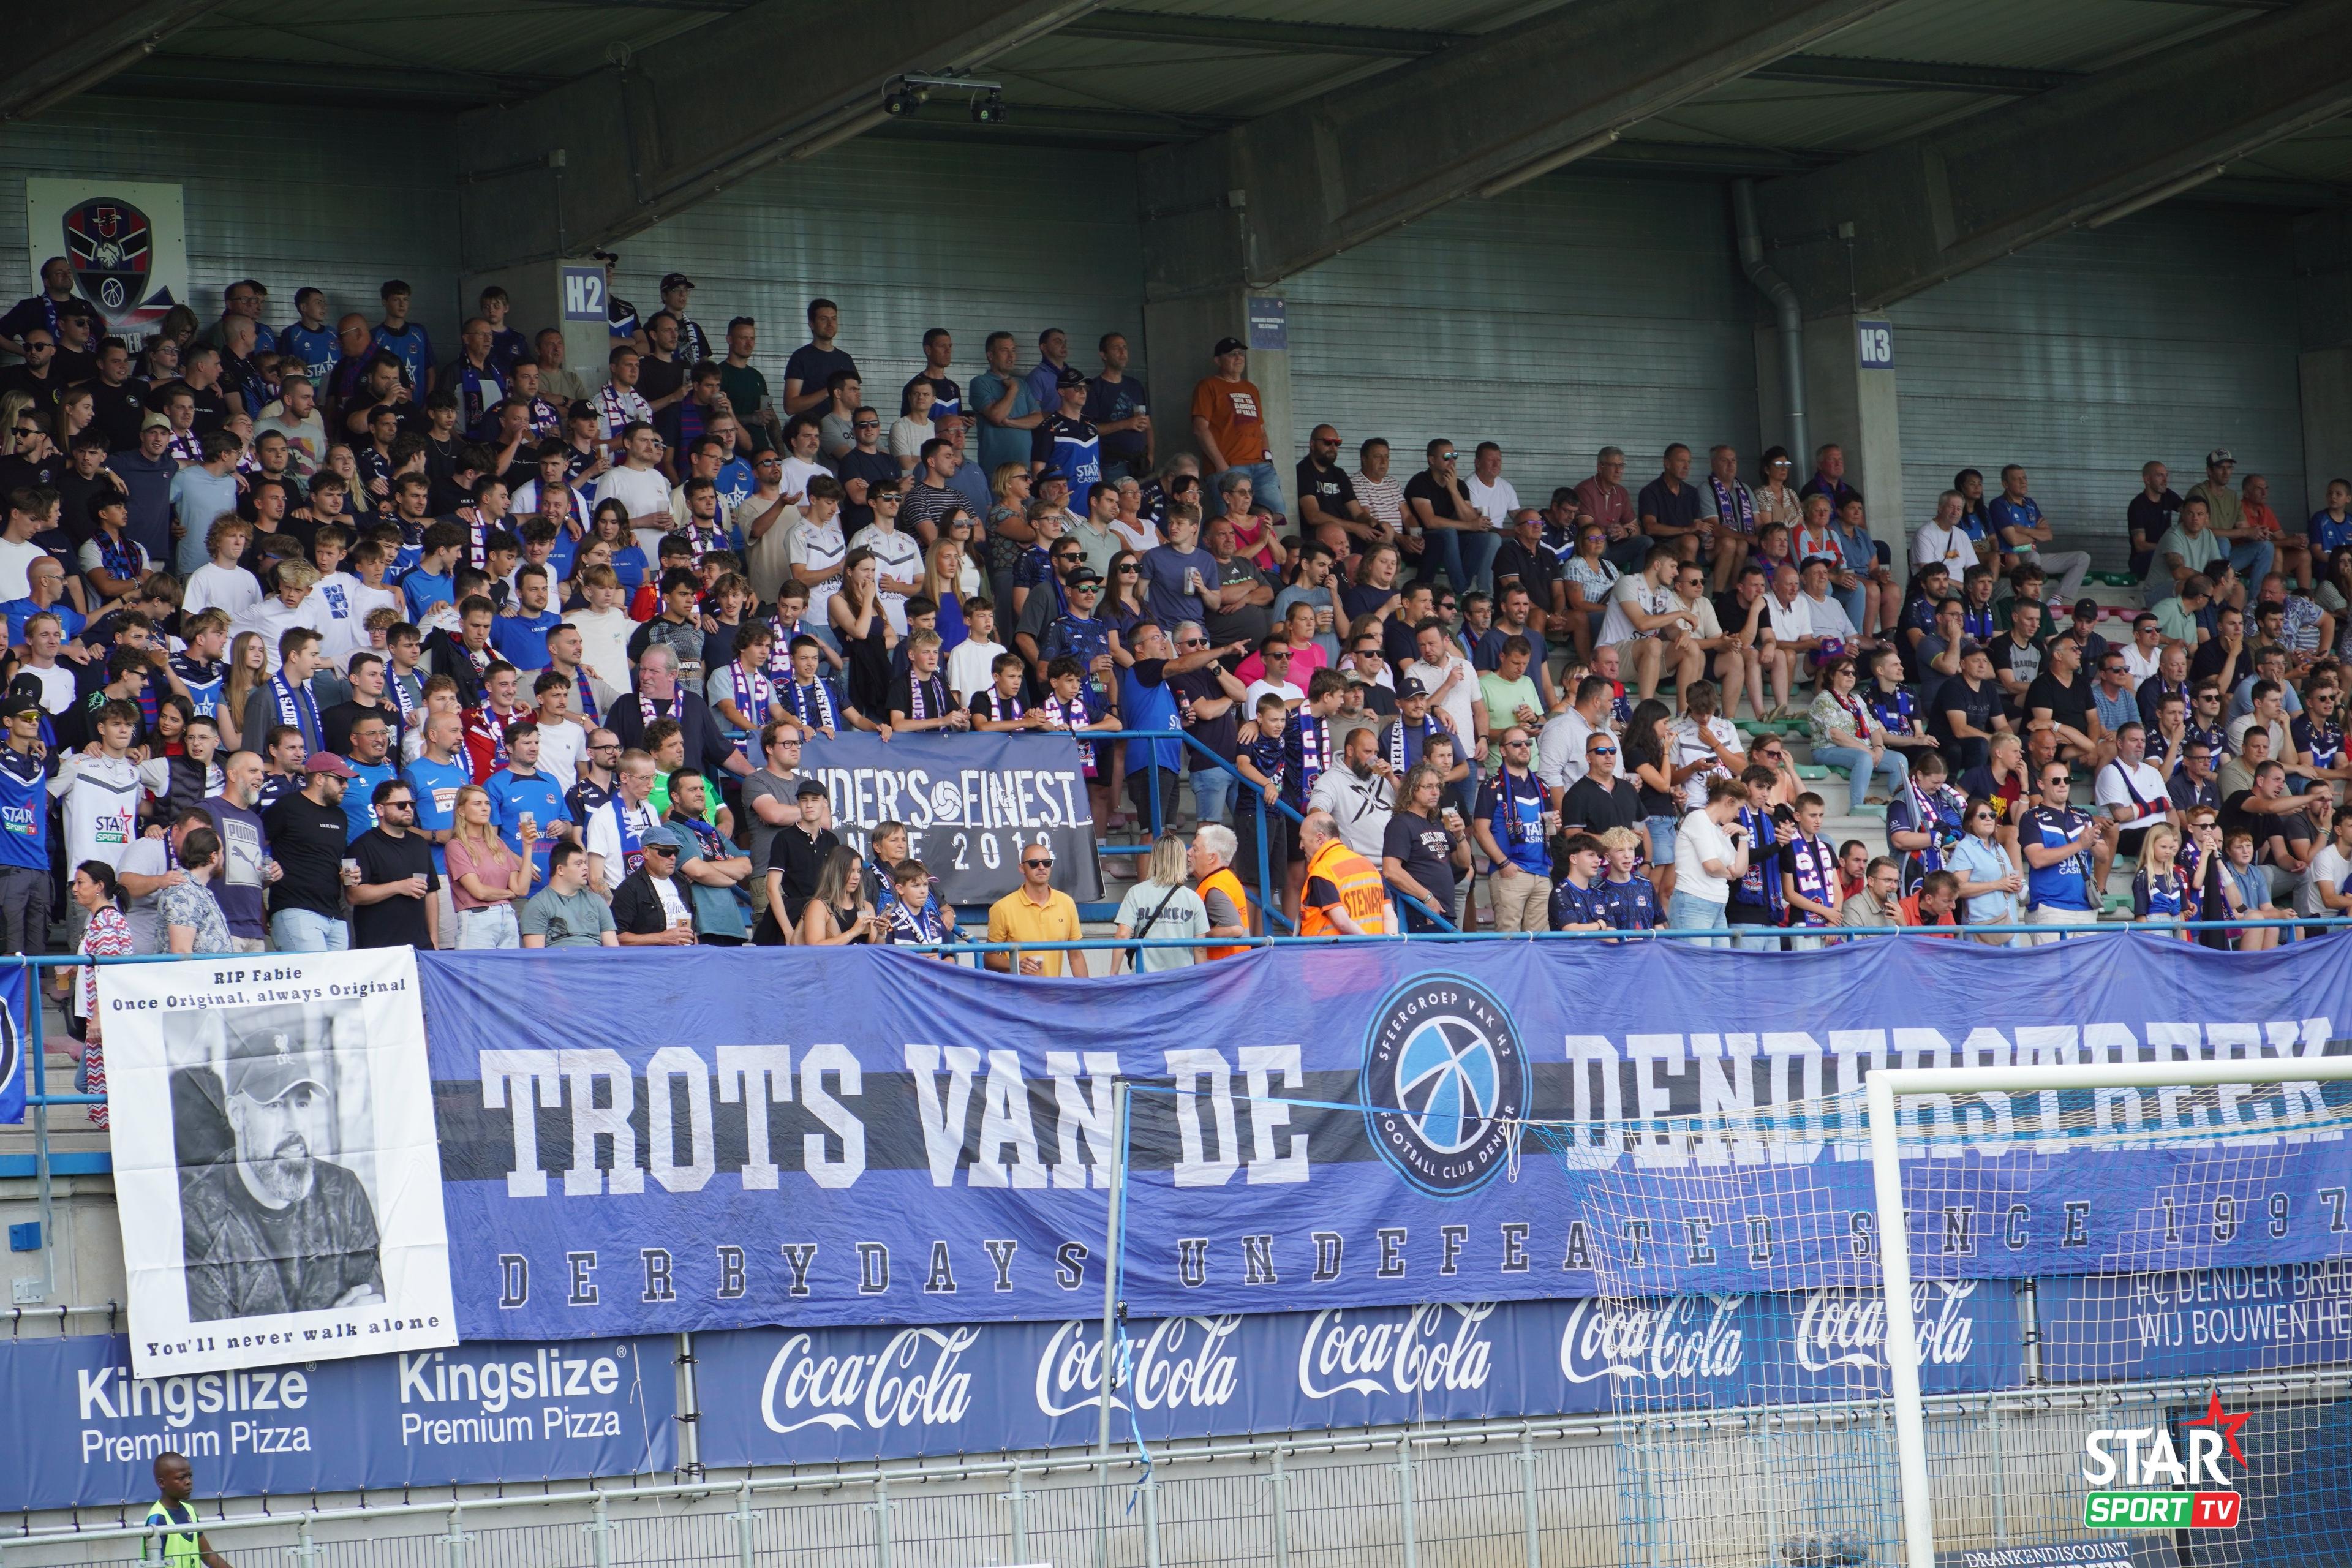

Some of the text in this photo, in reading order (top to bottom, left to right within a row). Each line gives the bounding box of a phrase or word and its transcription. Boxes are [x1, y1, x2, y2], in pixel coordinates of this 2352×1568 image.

[566, 276, 603, 313] H2
[1860, 328, 1891, 363] H3
[1076, 463, 1099, 478] STAR
[1390, 714, 1406, 772] ERSTREEK
[1697, 768, 1723, 781] STR
[2, 807, 35, 824] STAR
[791, 768, 1076, 831] DER'S FINEST
[6, 823, 27, 833] SPORT
[96, 816, 126, 832] STAR
[97, 833, 123, 842] SPORT
[228, 823, 258, 843] PUMA
[1525, 822, 1544, 836] TAR
[112, 978, 406, 1012] Once Original, always Original
[214, 967, 303, 985] RIP Fabie
[1379, 992, 1511, 1061] SFEERGROEP VAK H2
[479, 1044, 866, 1198] TROTS
[904, 1044, 1123, 1189] VAN
[1164, 1044, 1310, 1188] DE
[1380, 1104, 1515, 1179] FOOTBALL CLUB DENDER
[498, 1240, 1089, 1310] DERBYDAYS
[1177, 1214, 1774, 1289] UNDEFEATED
[2161, 1186, 2348, 1245] 1997
[2135, 1259, 2352, 1305] FC DENDER BREE
[147, 1315, 441, 1357] You'll never walk alone
[1559, 1292, 1748, 1384] Coca-Cola
[1796, 1278, 1979, 1372] CocaCola
[2136, 1298, 2352, 1348] WIJ BOUWEN HE
[1036, 1313, 1243, 1417] Coca-Cola
[1298, 1301, 1498, 1399] Coca-Cola
[78, 1366, 308, 1428] Kingslize
[399, 1348, 619, 1412] Kingslize
[761, 1325, 982, 1433] Coca-Cola
[82, 1421, 311, 1463] Premium Pizza
[402, 1406, 621, 1446] Premium Pizza
[1963, 1542, 2130, 1568] DRANKENDISCOUNT
